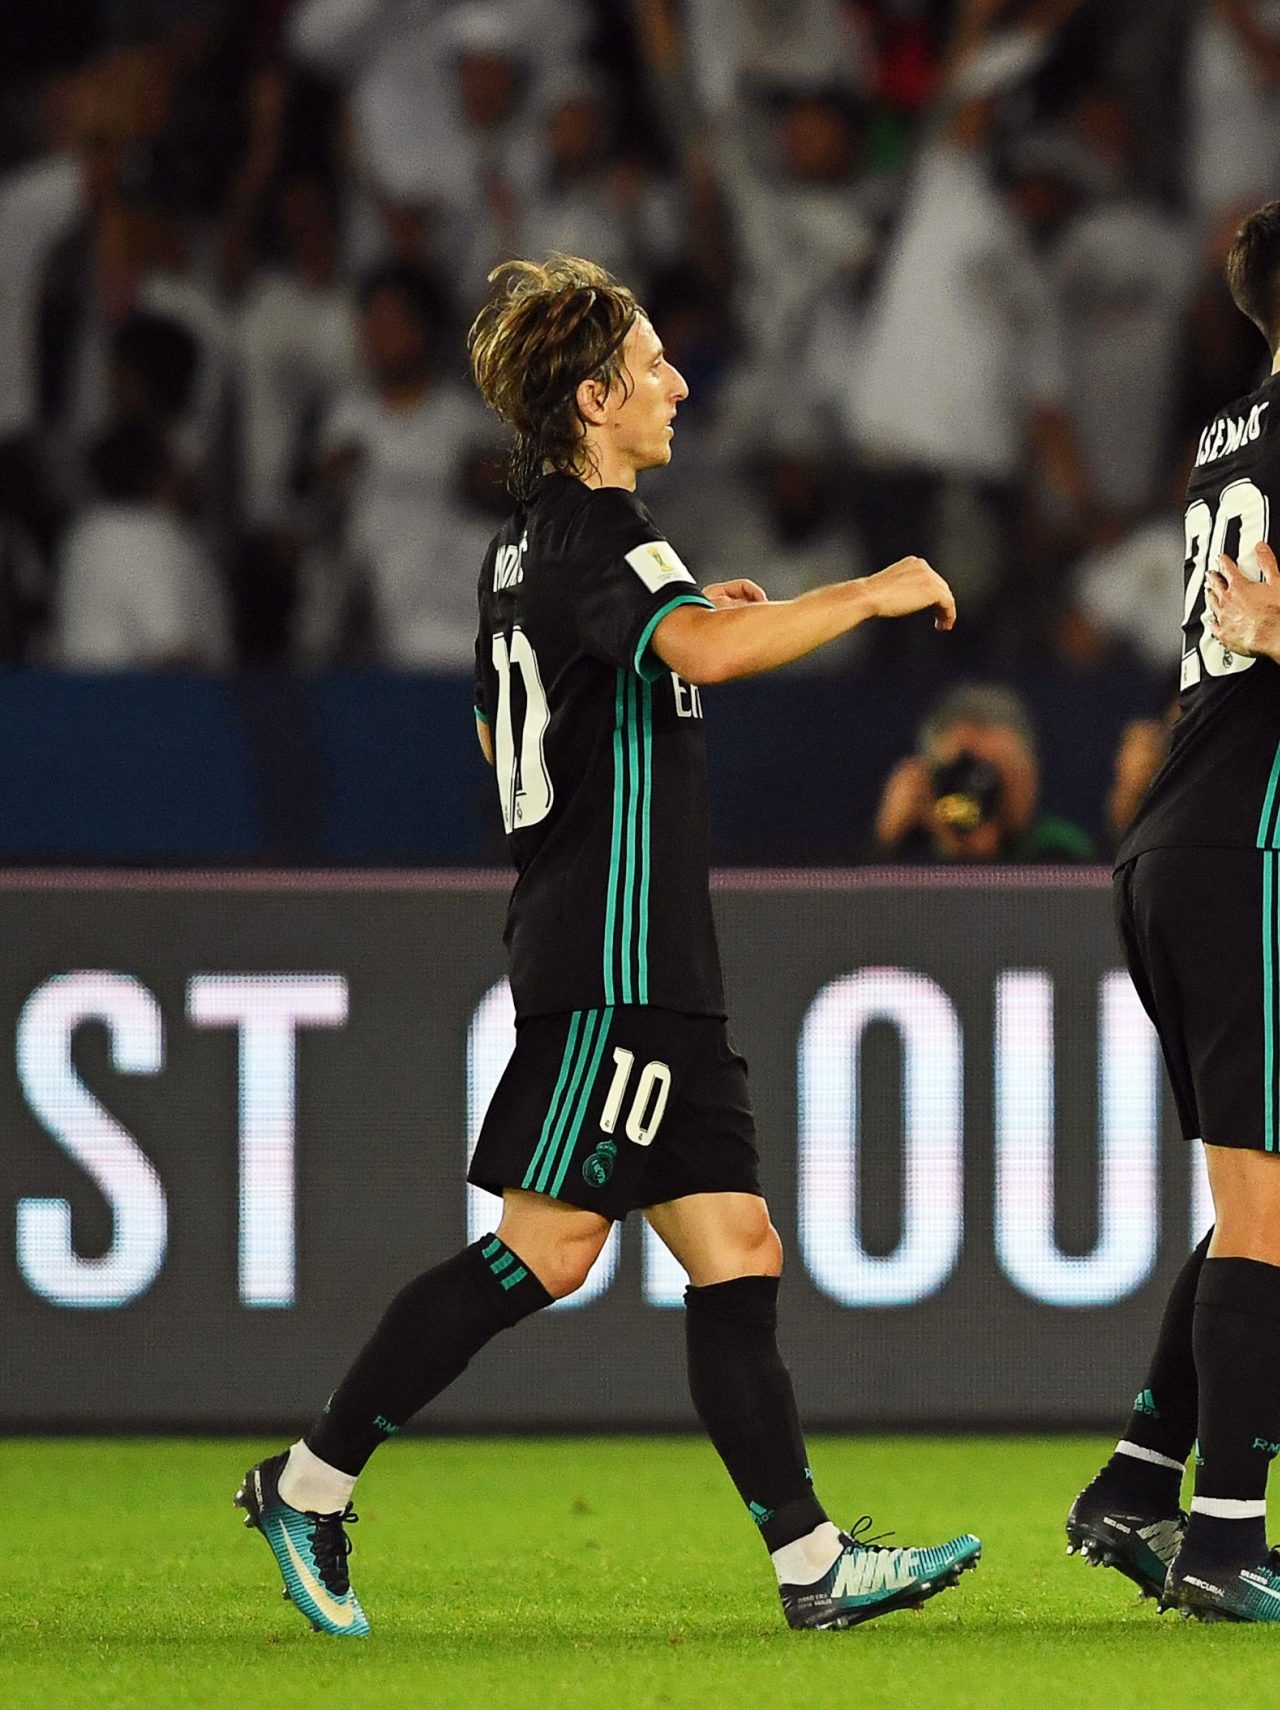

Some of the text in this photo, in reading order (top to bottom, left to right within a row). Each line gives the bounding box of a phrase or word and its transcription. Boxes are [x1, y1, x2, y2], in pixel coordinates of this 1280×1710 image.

[15, 969, 349, 1308] ST
[599, 1046, 672, 1147] 10
[830, 1548, 921, 1599] NIKE
